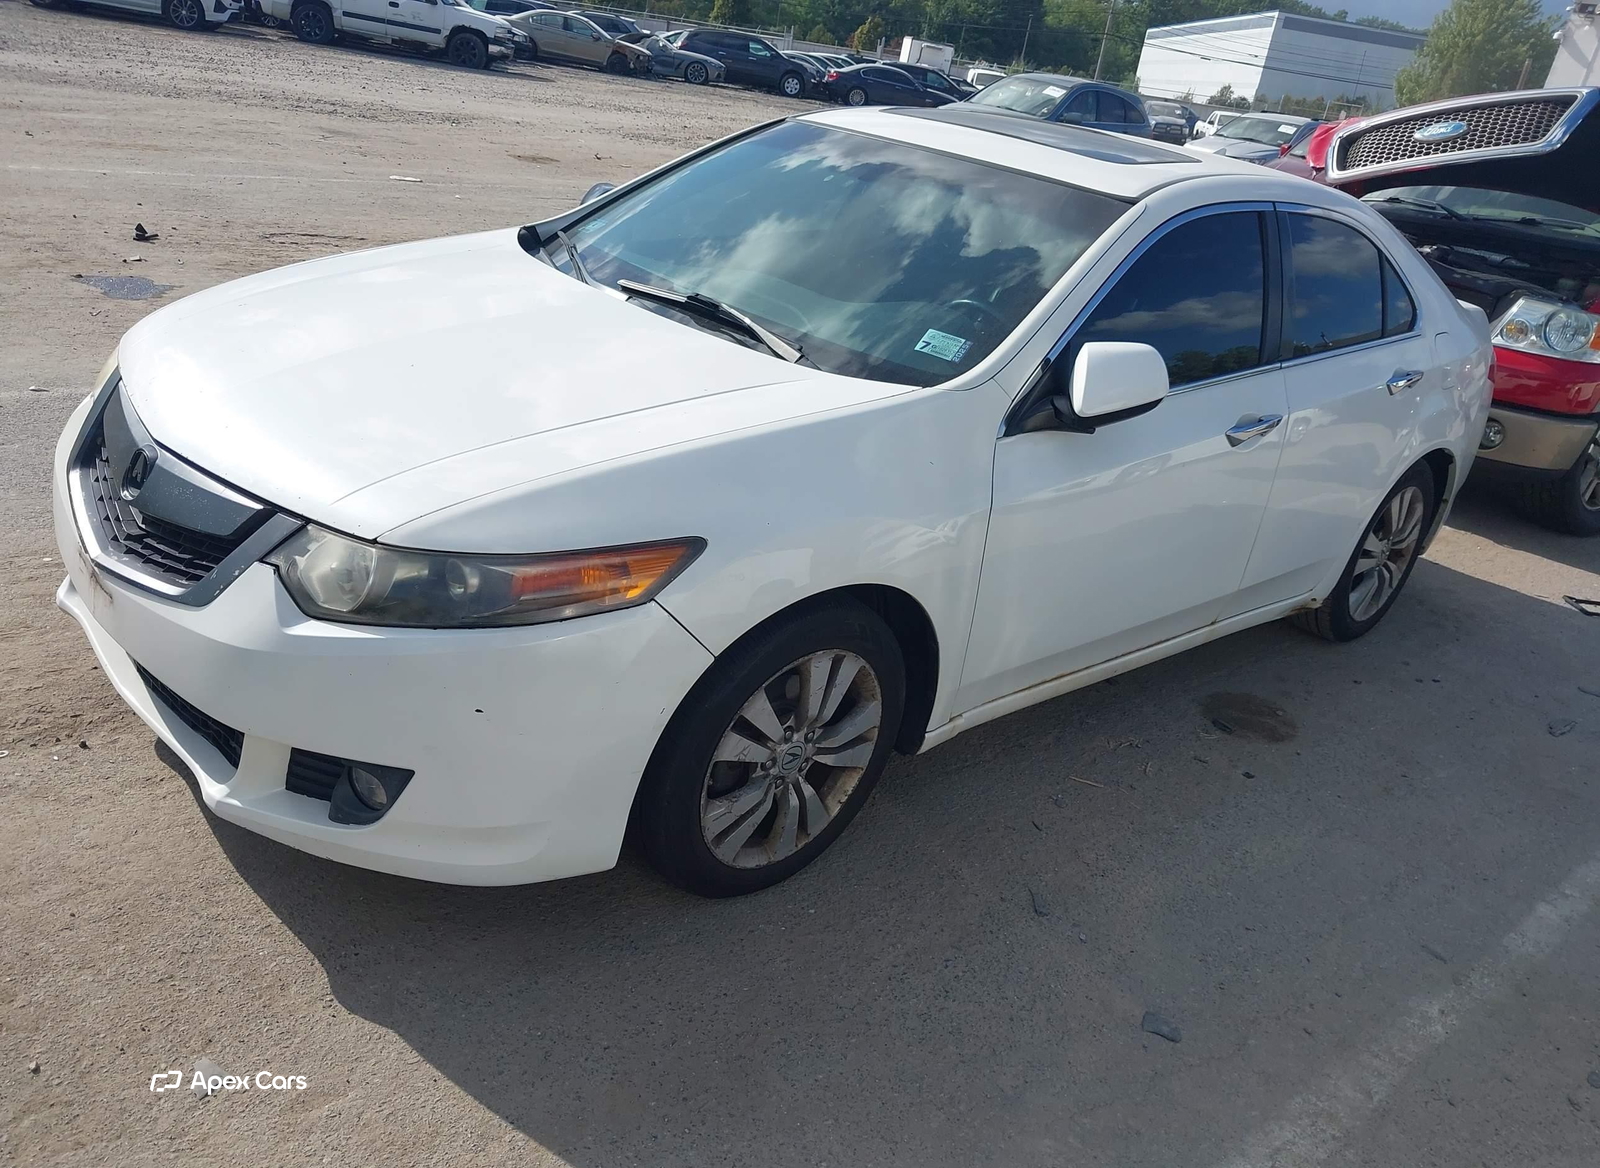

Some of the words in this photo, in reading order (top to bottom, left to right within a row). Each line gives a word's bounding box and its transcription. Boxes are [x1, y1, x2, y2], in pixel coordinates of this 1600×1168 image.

[1422, 123, 1455, 136] Ford
[919, 341, 931, 350] 7
[952, 344, 969, 362] 2025
